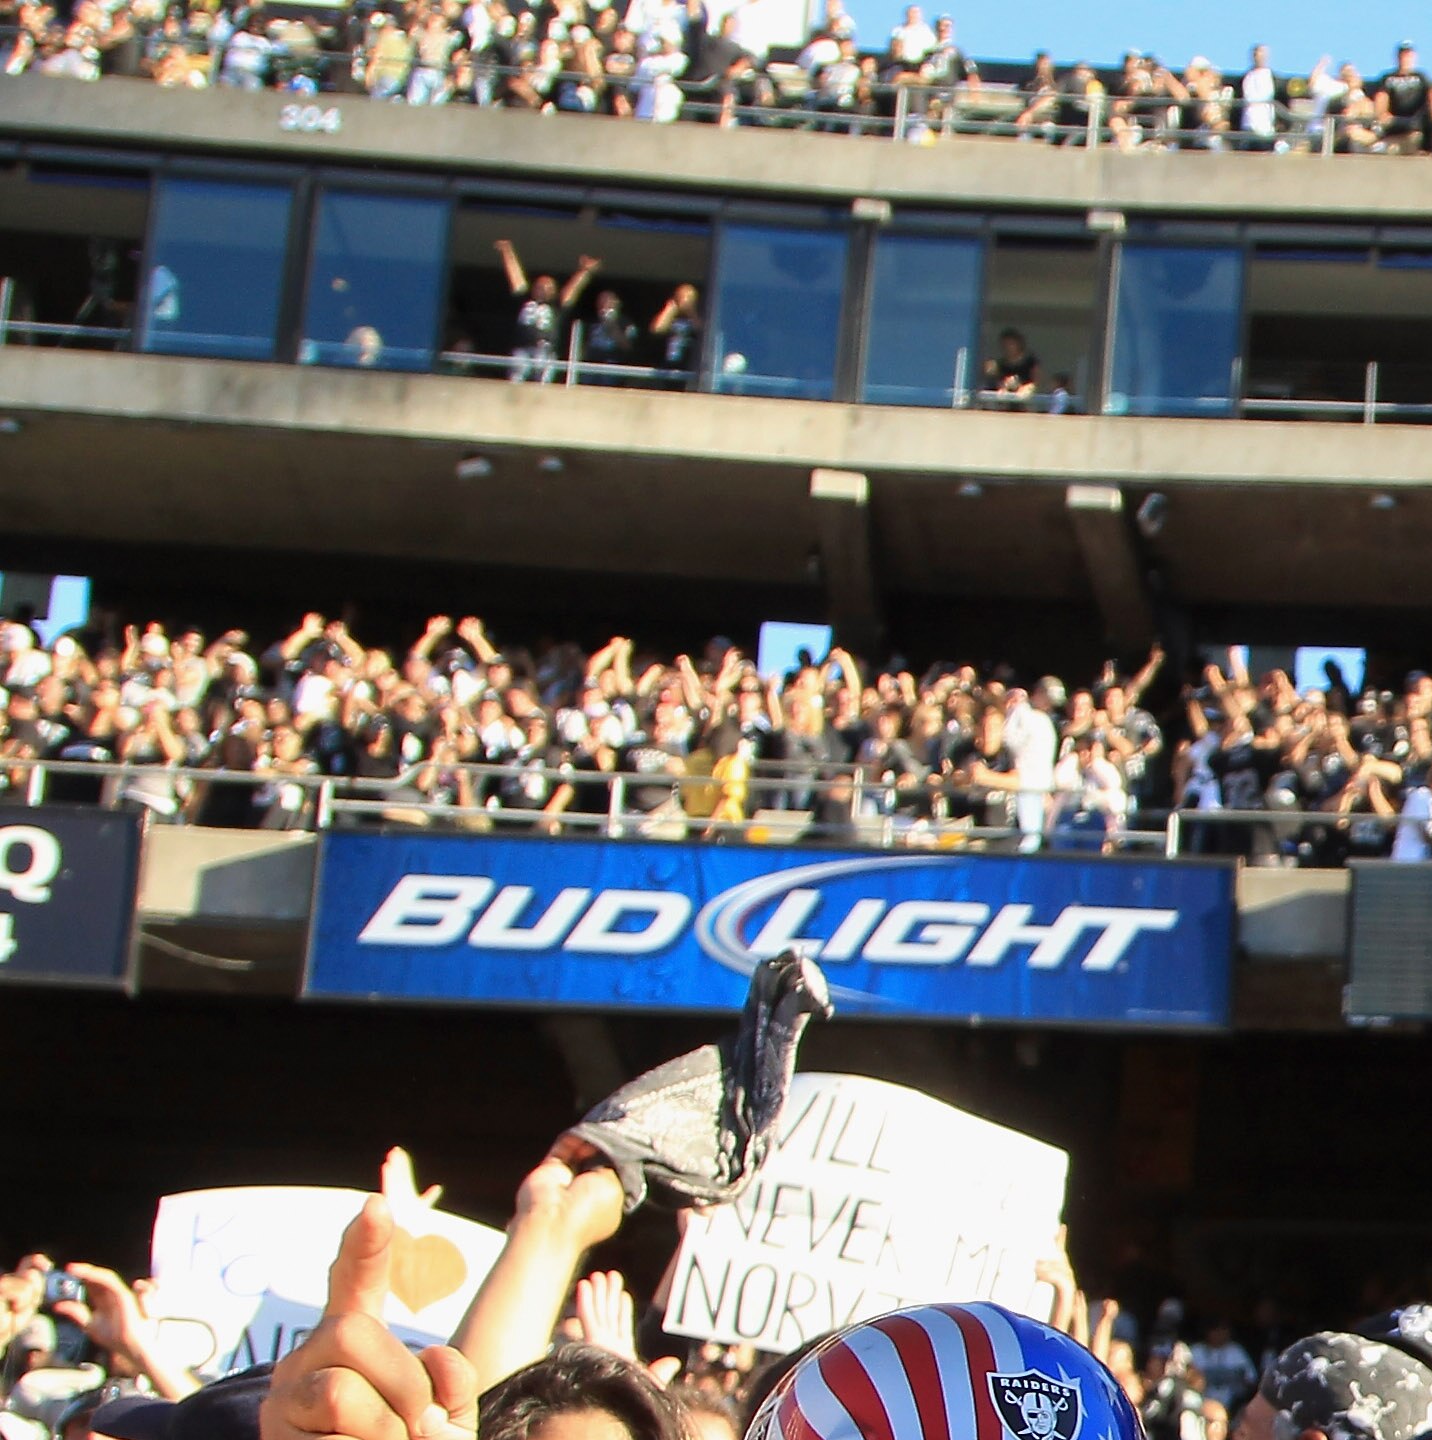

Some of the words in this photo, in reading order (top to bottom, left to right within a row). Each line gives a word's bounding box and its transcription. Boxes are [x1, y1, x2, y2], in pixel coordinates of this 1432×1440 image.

[356, 873, 693, 956] BUD
[744, 887, 1180, 972] LIGHT
[1000, 1378, 1071, 1397] RAIDERS
